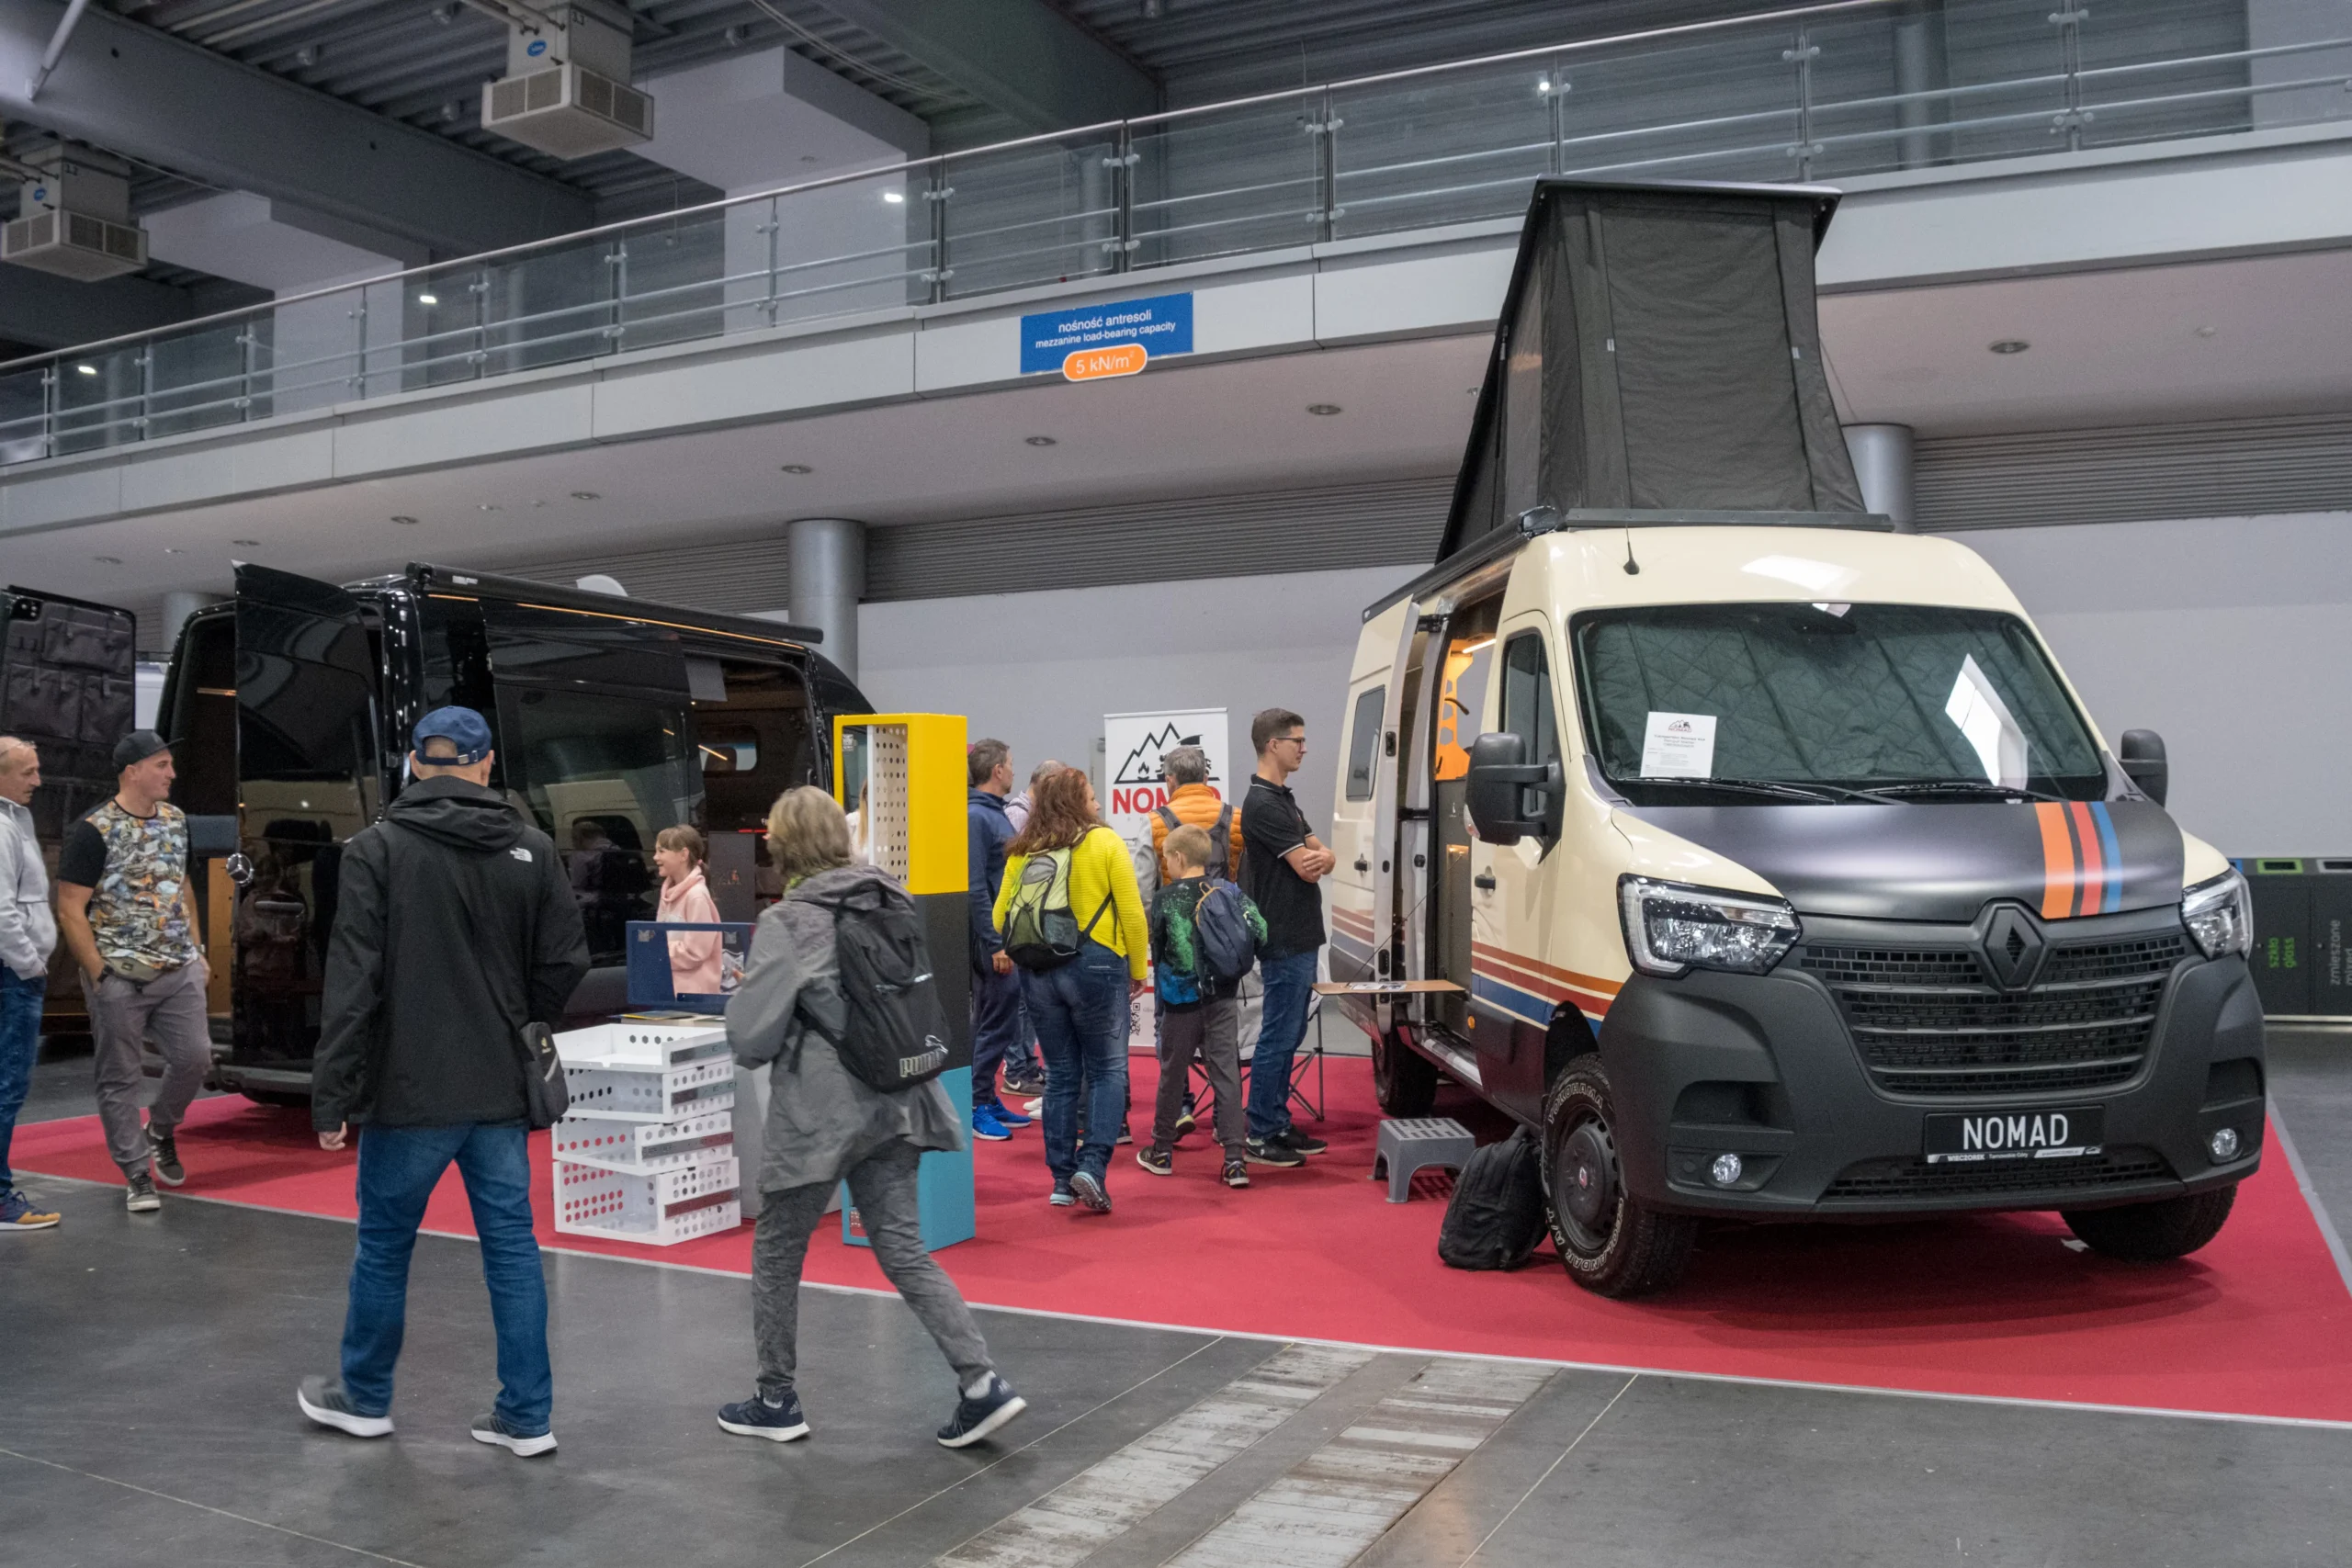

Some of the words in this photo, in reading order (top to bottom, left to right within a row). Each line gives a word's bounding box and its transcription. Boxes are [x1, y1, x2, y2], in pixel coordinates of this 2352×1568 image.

[1035, 334, 1081, 348] mezzanine
[1083, 327, 1137, 342] load-bearing
[1139, 321, 1176, 335] capacity
[1058, 316, 1103, 333] nośność
[1105, 309, 1152, 327] antresoli
[1076, 359, 1085, 375] 5
[1547, 1082, 1603, 1124] YOKOHAMA
[1962, 1113, 2068, 1150] NOMAD
[1947, 1154, 1985, 1162] WIECZOREK
[1565, 1197, 1624, 1271] GEOLANDAR
